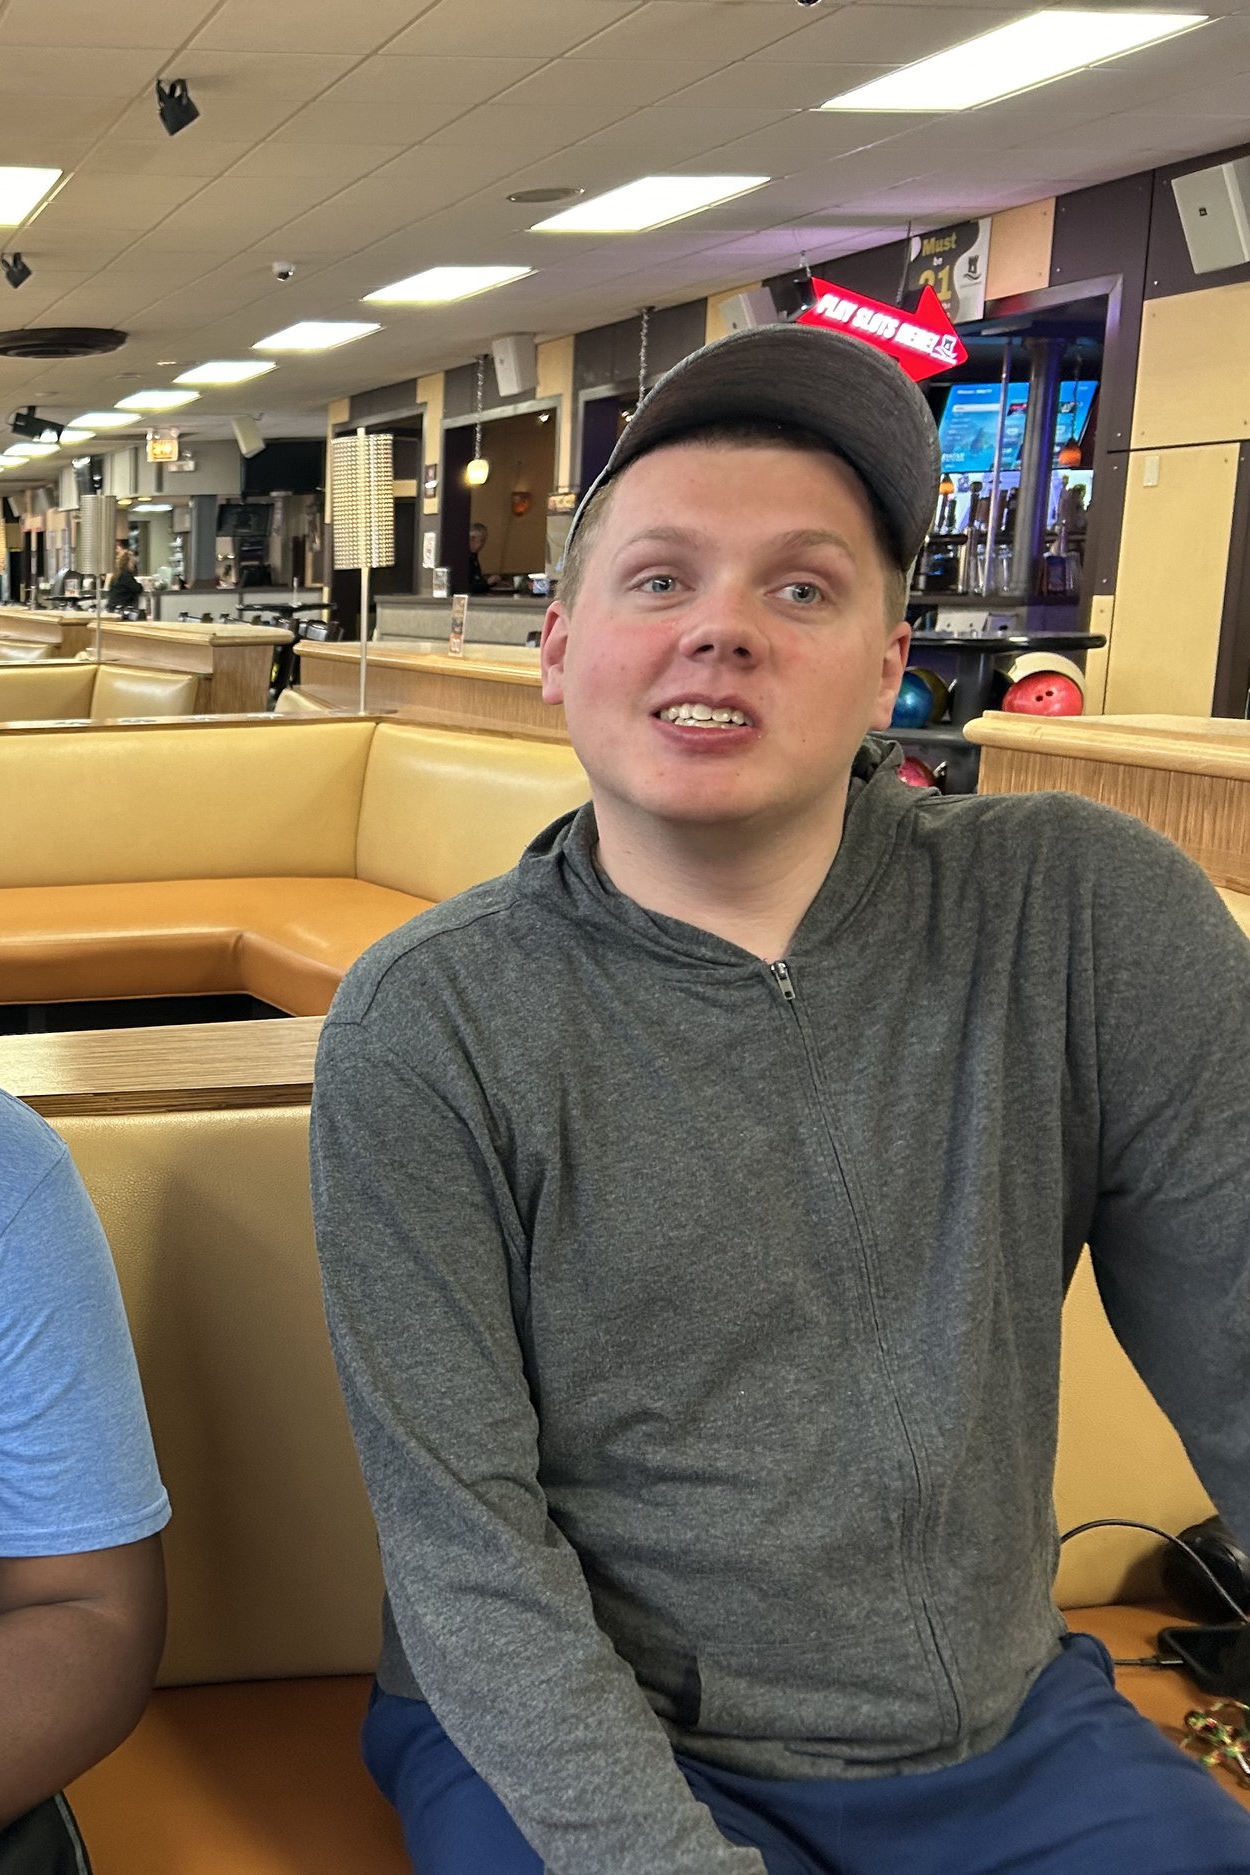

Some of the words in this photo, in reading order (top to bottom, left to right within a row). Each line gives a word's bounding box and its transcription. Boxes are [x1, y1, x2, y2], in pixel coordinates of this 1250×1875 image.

[922, 231, 957, 257] Must
[816, 293, 858, 323] PLAY
[852, 307, 900, 339] SLOTS
